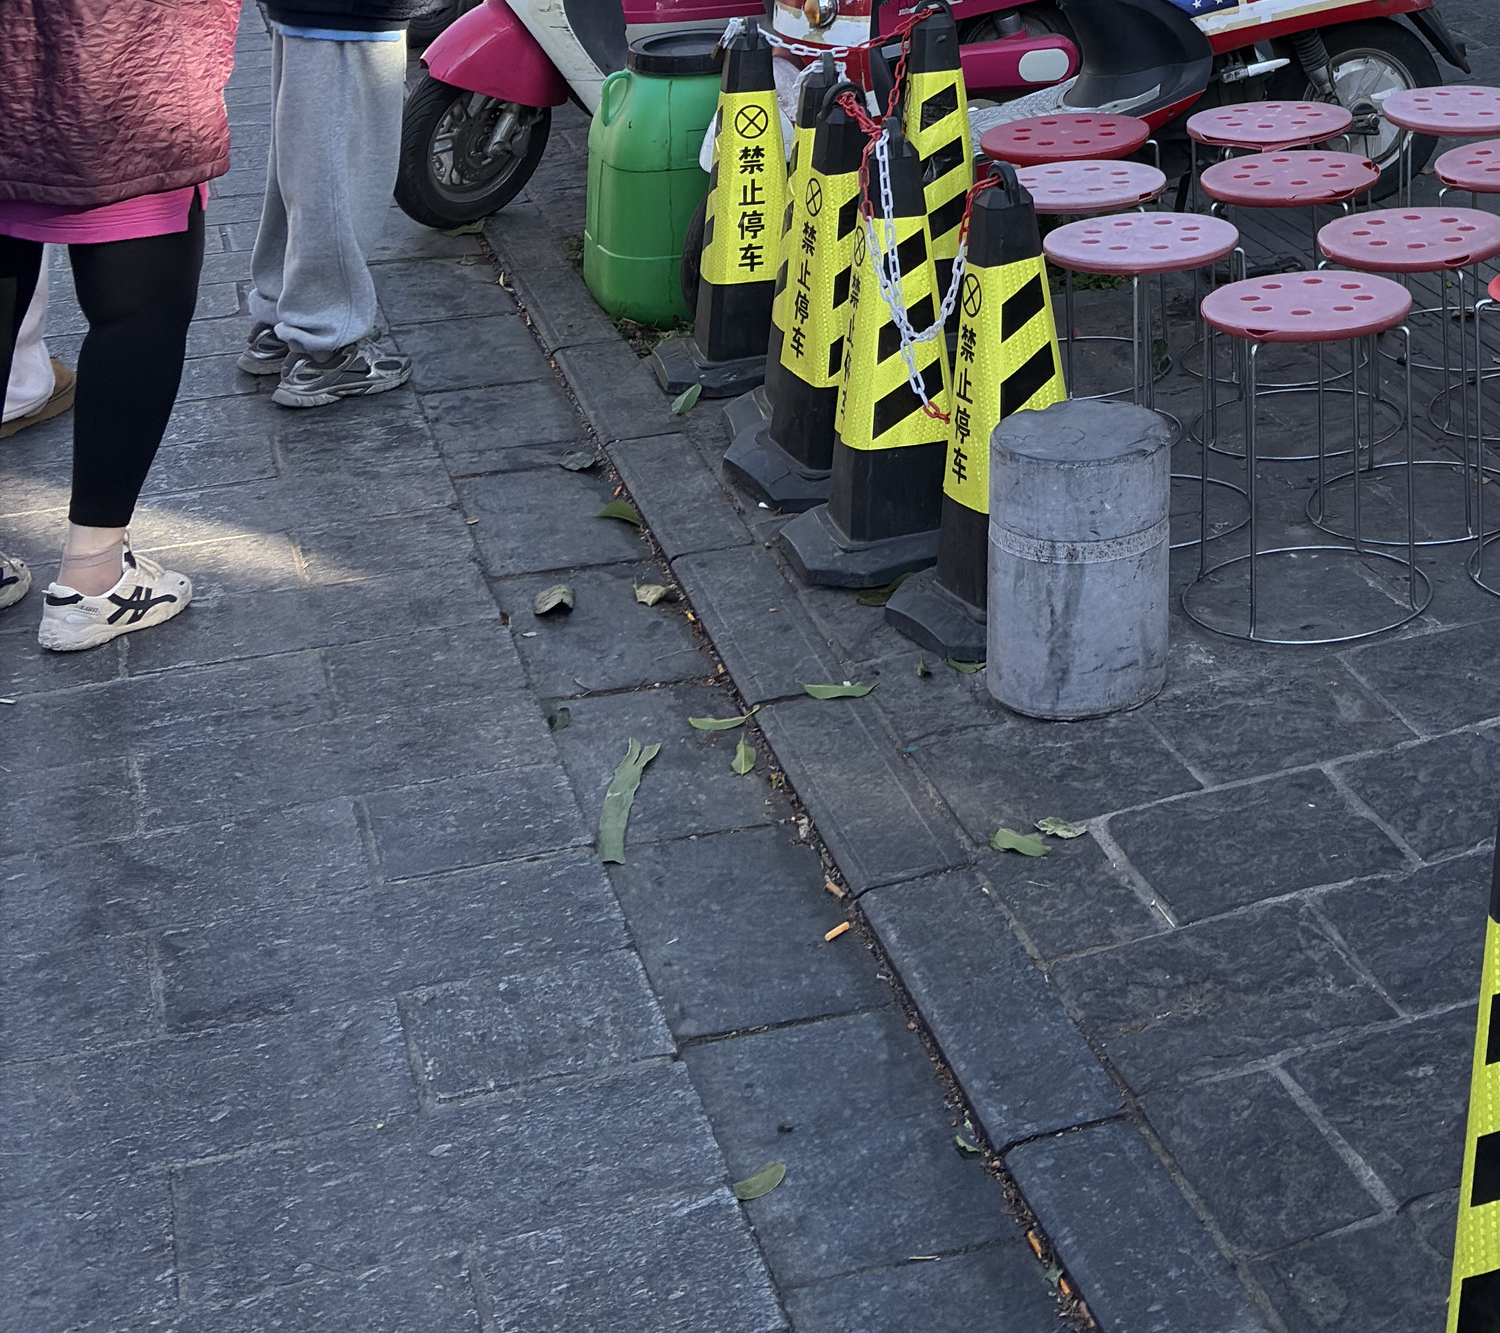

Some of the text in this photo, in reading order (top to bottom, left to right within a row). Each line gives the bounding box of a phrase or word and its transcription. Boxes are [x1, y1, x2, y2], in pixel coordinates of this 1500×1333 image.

[738, 146, 766, 273] 禁止停车
[790, 221, 817, 359] 禁止停车
[952, 323, 977, 484] 禁止停车
